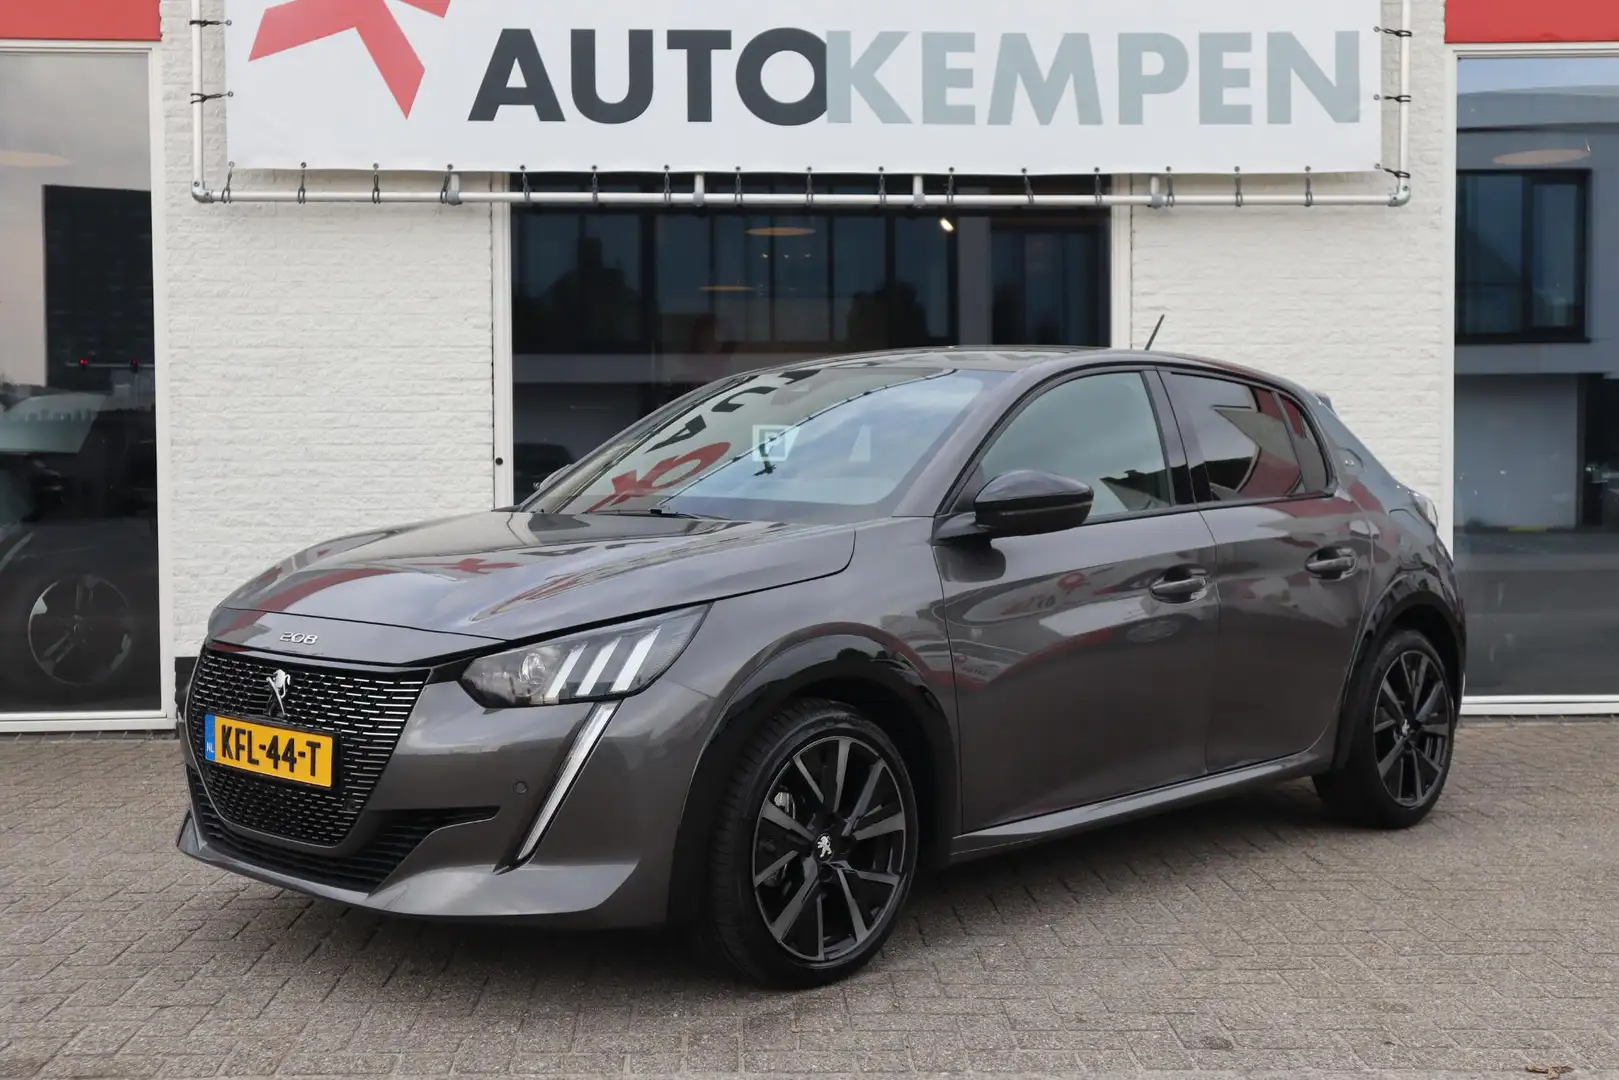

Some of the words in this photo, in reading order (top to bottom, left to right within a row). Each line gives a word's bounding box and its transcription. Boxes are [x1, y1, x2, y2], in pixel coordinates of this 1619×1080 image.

[279, 631, 318, 645] 208
[206, 742, 215, 753] NL
[221, 724, 322, 777] KFL-44-T
